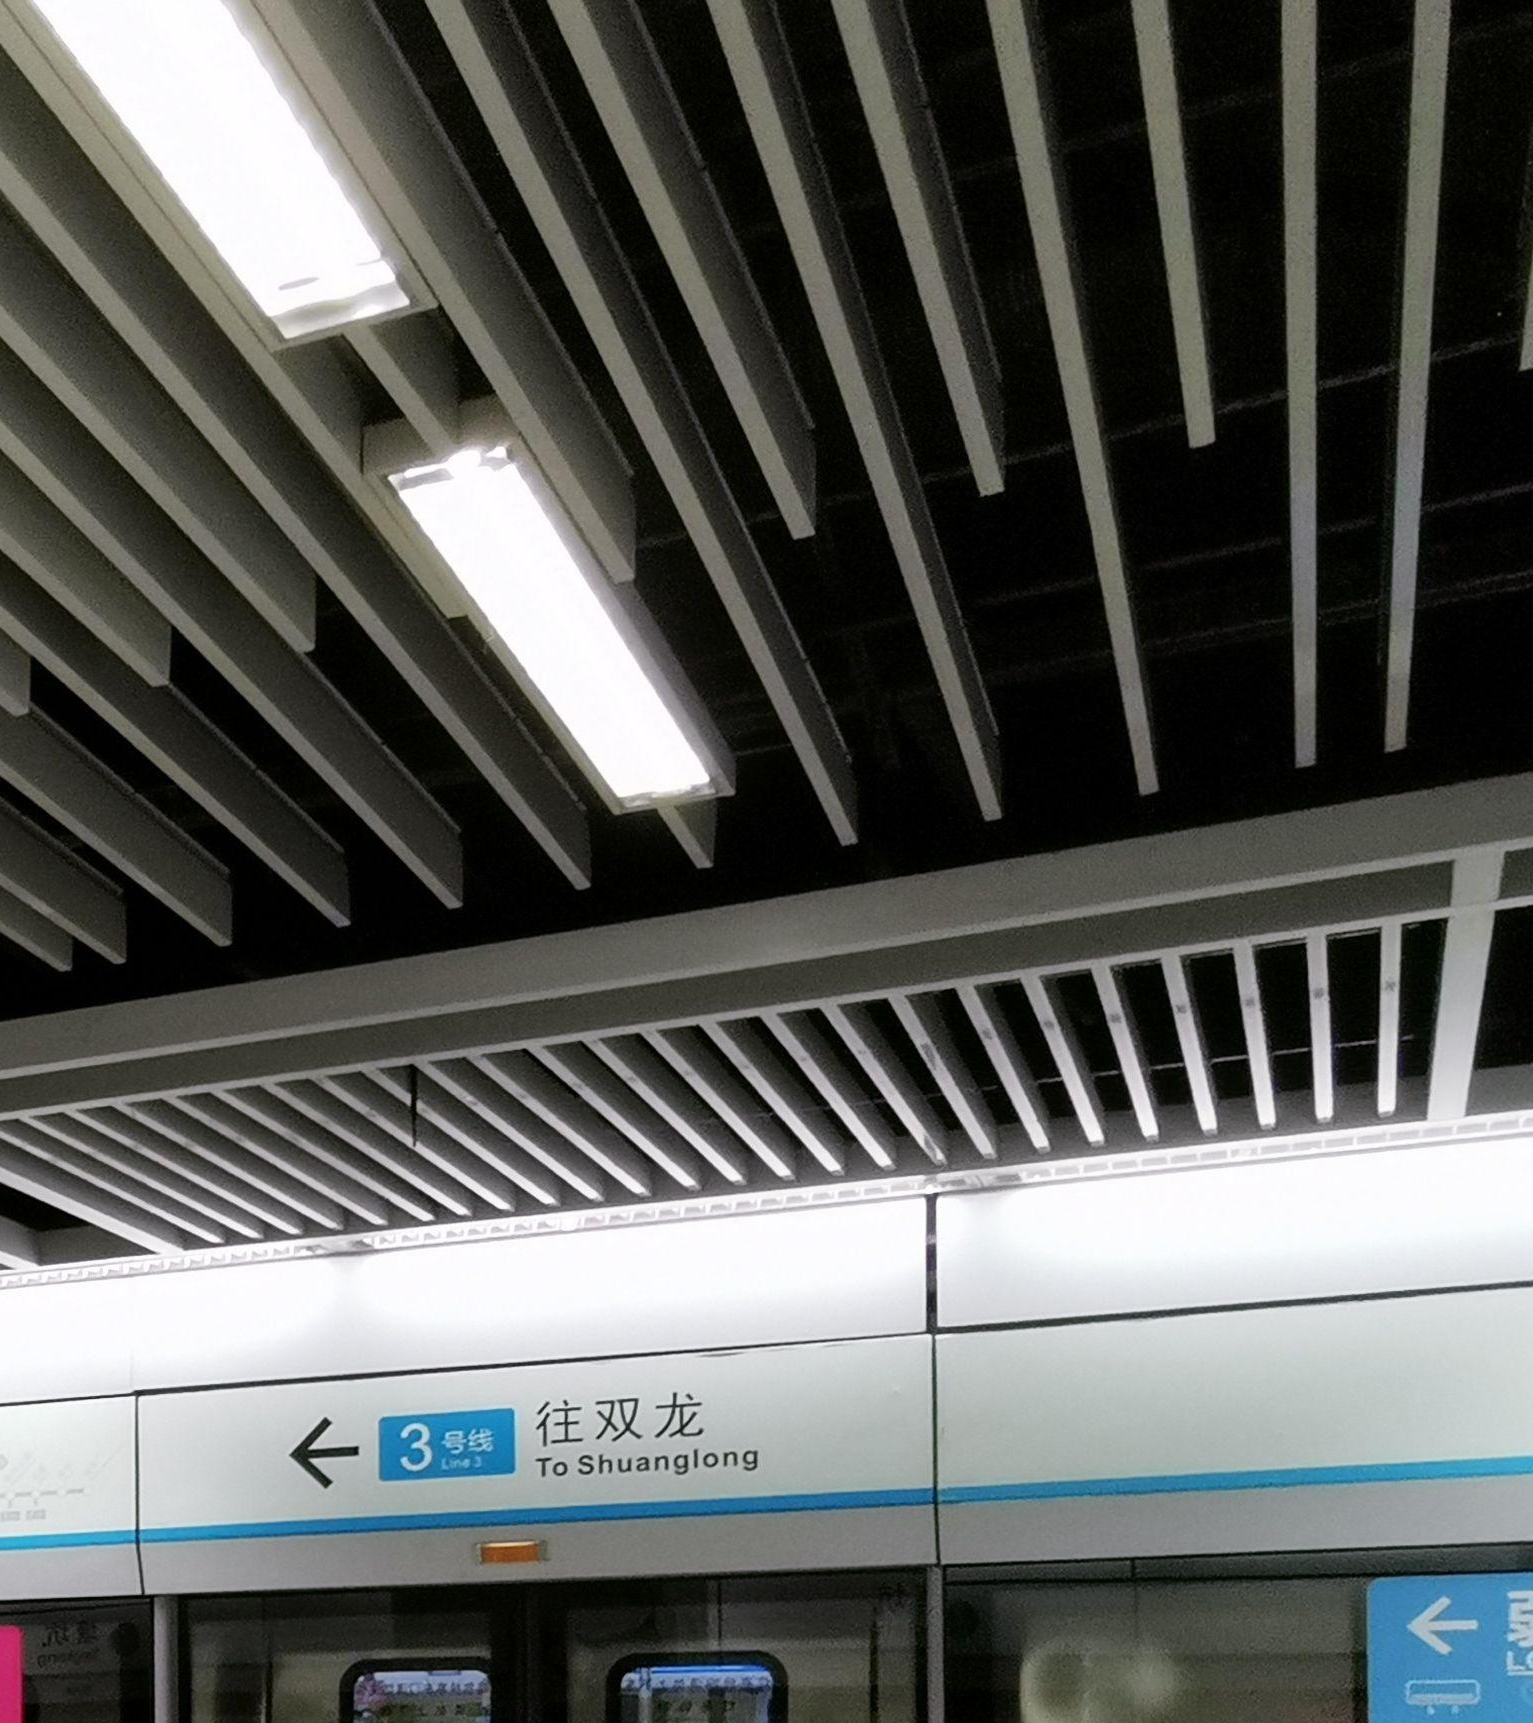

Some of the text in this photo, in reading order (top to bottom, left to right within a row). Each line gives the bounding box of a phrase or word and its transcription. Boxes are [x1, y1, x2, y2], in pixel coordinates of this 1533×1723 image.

[535, 1391, 705, 1448] 往双龙
[441, 1456, 471, 1470] Line
[536, 1448, 759, 1478] To Shuanglong
